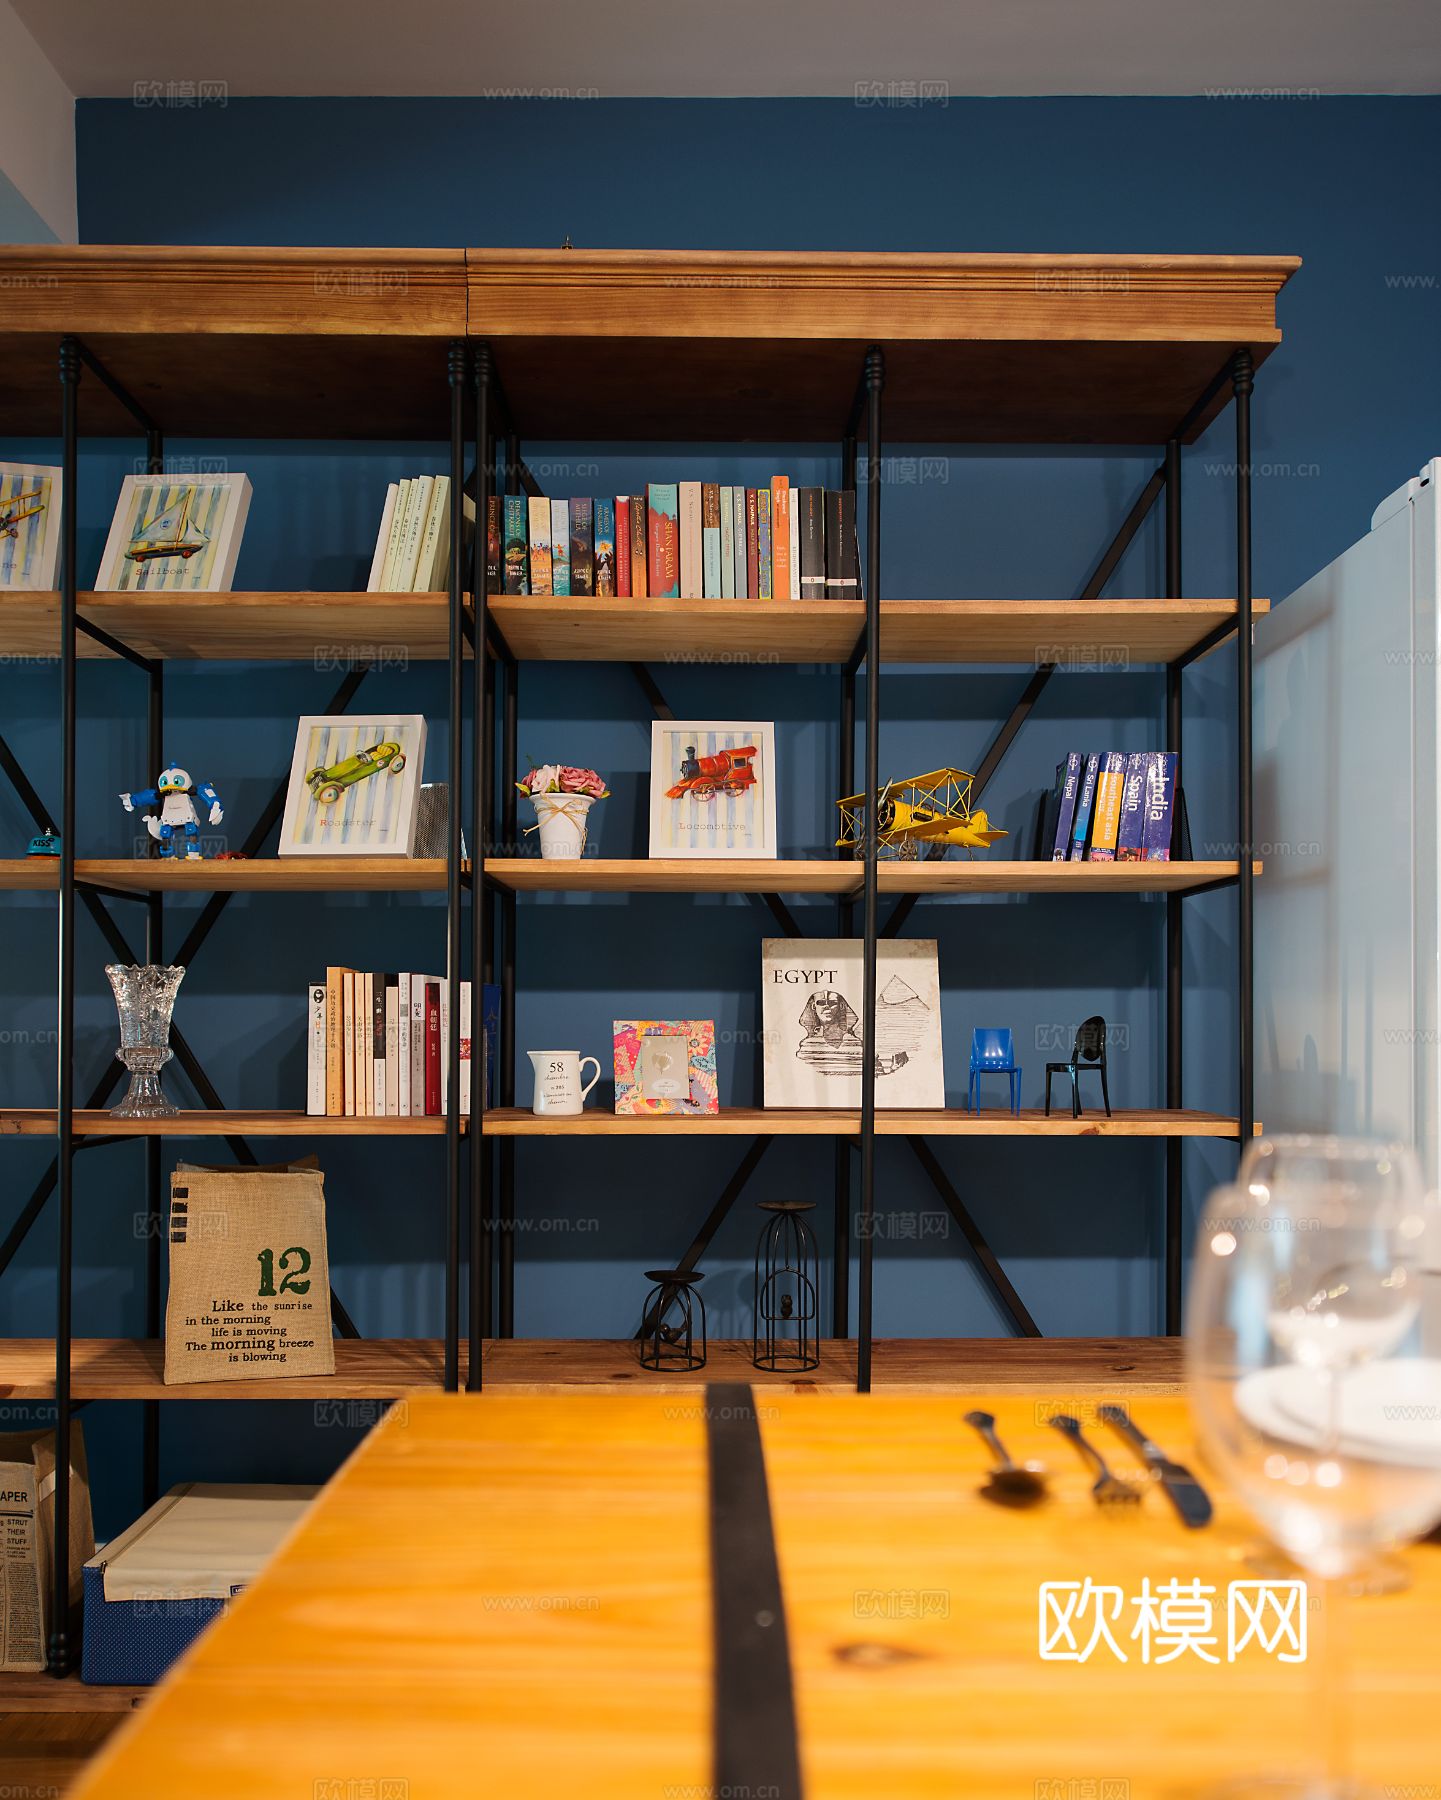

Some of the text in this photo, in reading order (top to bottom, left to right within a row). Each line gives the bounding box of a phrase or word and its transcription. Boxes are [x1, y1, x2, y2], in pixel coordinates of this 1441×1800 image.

[665, 521, 674, 578] SHANTARAM
[135, 566, 190, 577] Sailboat
[1065, 775, 1076, 799] Nepal
[1082, 774, 1095, 808] Sri Lanka
[1127, 775, 1143, 811] Spain
[1150, 777, 1170, 822] India
[1103, 776, 1118, 841] southeast asia
[319, 817, 377, 828] Roadster
[678, 821, 747, 832] Locomotive
[32, 839, 51, 848] KISS
[772, 969, 838, 985] EGYPT
[549, 1061, 564, 1073] 58
[257, 1246, 312, 1297] 12
[212, 1300, 313, 1312] Like the sunrise
[185, 1315, 271, 1327] in the morning
[211, 1326, 287, 1338] life is moving
[185, 1337, 315, 1352] The morning breeze
[228, 1352, 287, 1364] is blowing
[0, 1491, 28, 1503] APER
[7, 1528, 26, 1536] THEIR
